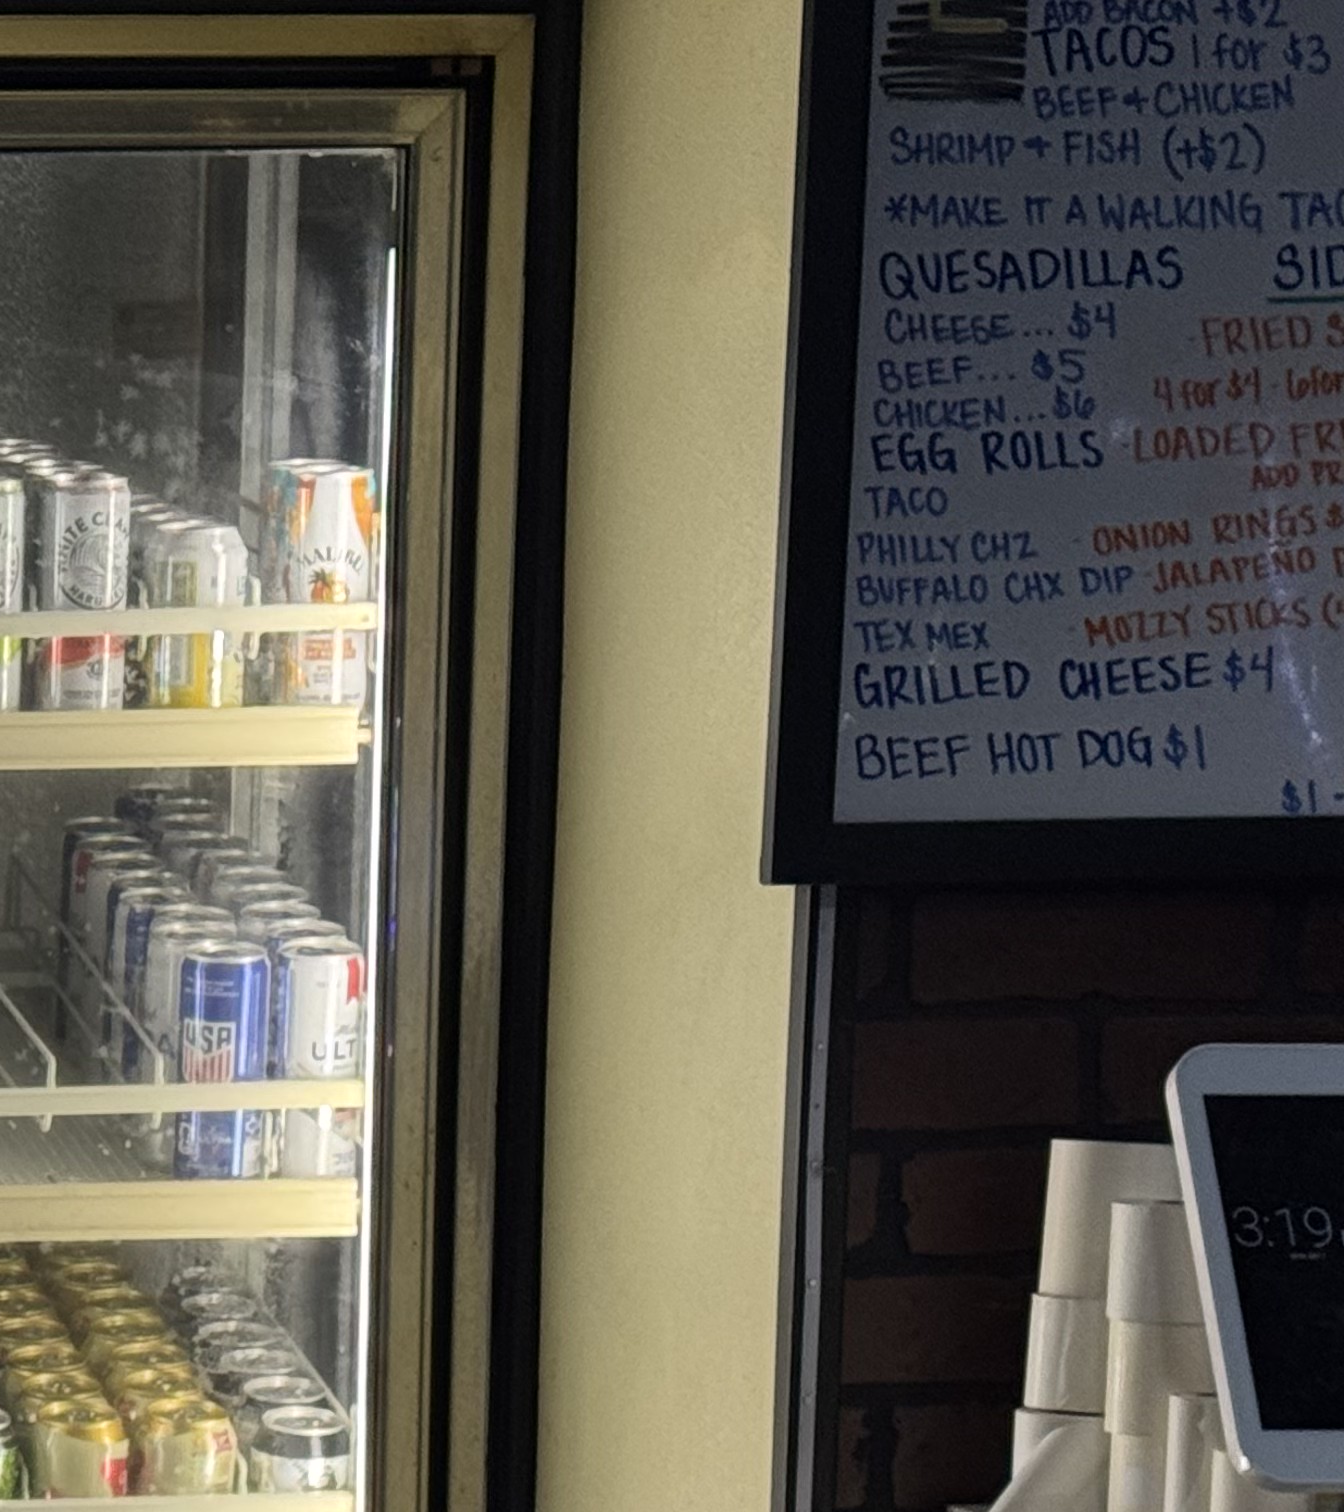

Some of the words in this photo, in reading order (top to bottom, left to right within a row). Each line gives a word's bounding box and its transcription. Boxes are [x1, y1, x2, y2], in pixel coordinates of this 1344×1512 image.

[1032, 25, 1175, 77] TACOS
[1284, 33, 1332, 75] $3
[1033, 84, 1121, 120] BEEF
[1154, 76, 1295, 119] CHICKEN
[889, 127, 1014, 167] SHRIMP
[1064, 127, 1141, 165] FISH
[1163, 122, 1267, 182] (+$2)
[1026, 195, 1055, 226] IT
[1065, 195, 1088, 225] A
[1099, 192, 1263, 233] WALKING
[878, 246, 1184, 300] QUESADILLAS
[1069, 301, 1116, 340] $4
[1199, 315, 1312, 358] FRIED
[1031, 349, 1085, 383] $5
[871, 432, 958, 477] EGG
[982, 431, 1104, 475] ROLLS
[1133, 421, 1275, 464] LOADED
[865, 486, 949, 520] TACO
[857, 532, 961, 566] PHILLY
[1092, 519, 1191, 557] ONION
[1212, 504, 1318, 545] RINGS
[856, 573, 990, 608] BUFFALO
[1004, 571, 1066, 602] CHX
[1079, 566, 1135, 597] DIP
[855, 621, 914, 653] TEX
[925, 621, 992, 651] MEX
[855, 660, 1031, 709] GRILLED
[1060, 651, 1212, 702] CHEESE
[1223, 645, 1275, 692] $4
[856, 733, 972, 780] BEEF
[988, 731, 1061, 776] HOT
[1078, 727, 1154, 769] DOG
[1163, 723, 1207, 771] $1
[1281, 779, 1317, 814] $1
[185, 1024, 233, 1056] USA
[1232, 1205, 1333, 1249] 3:19
